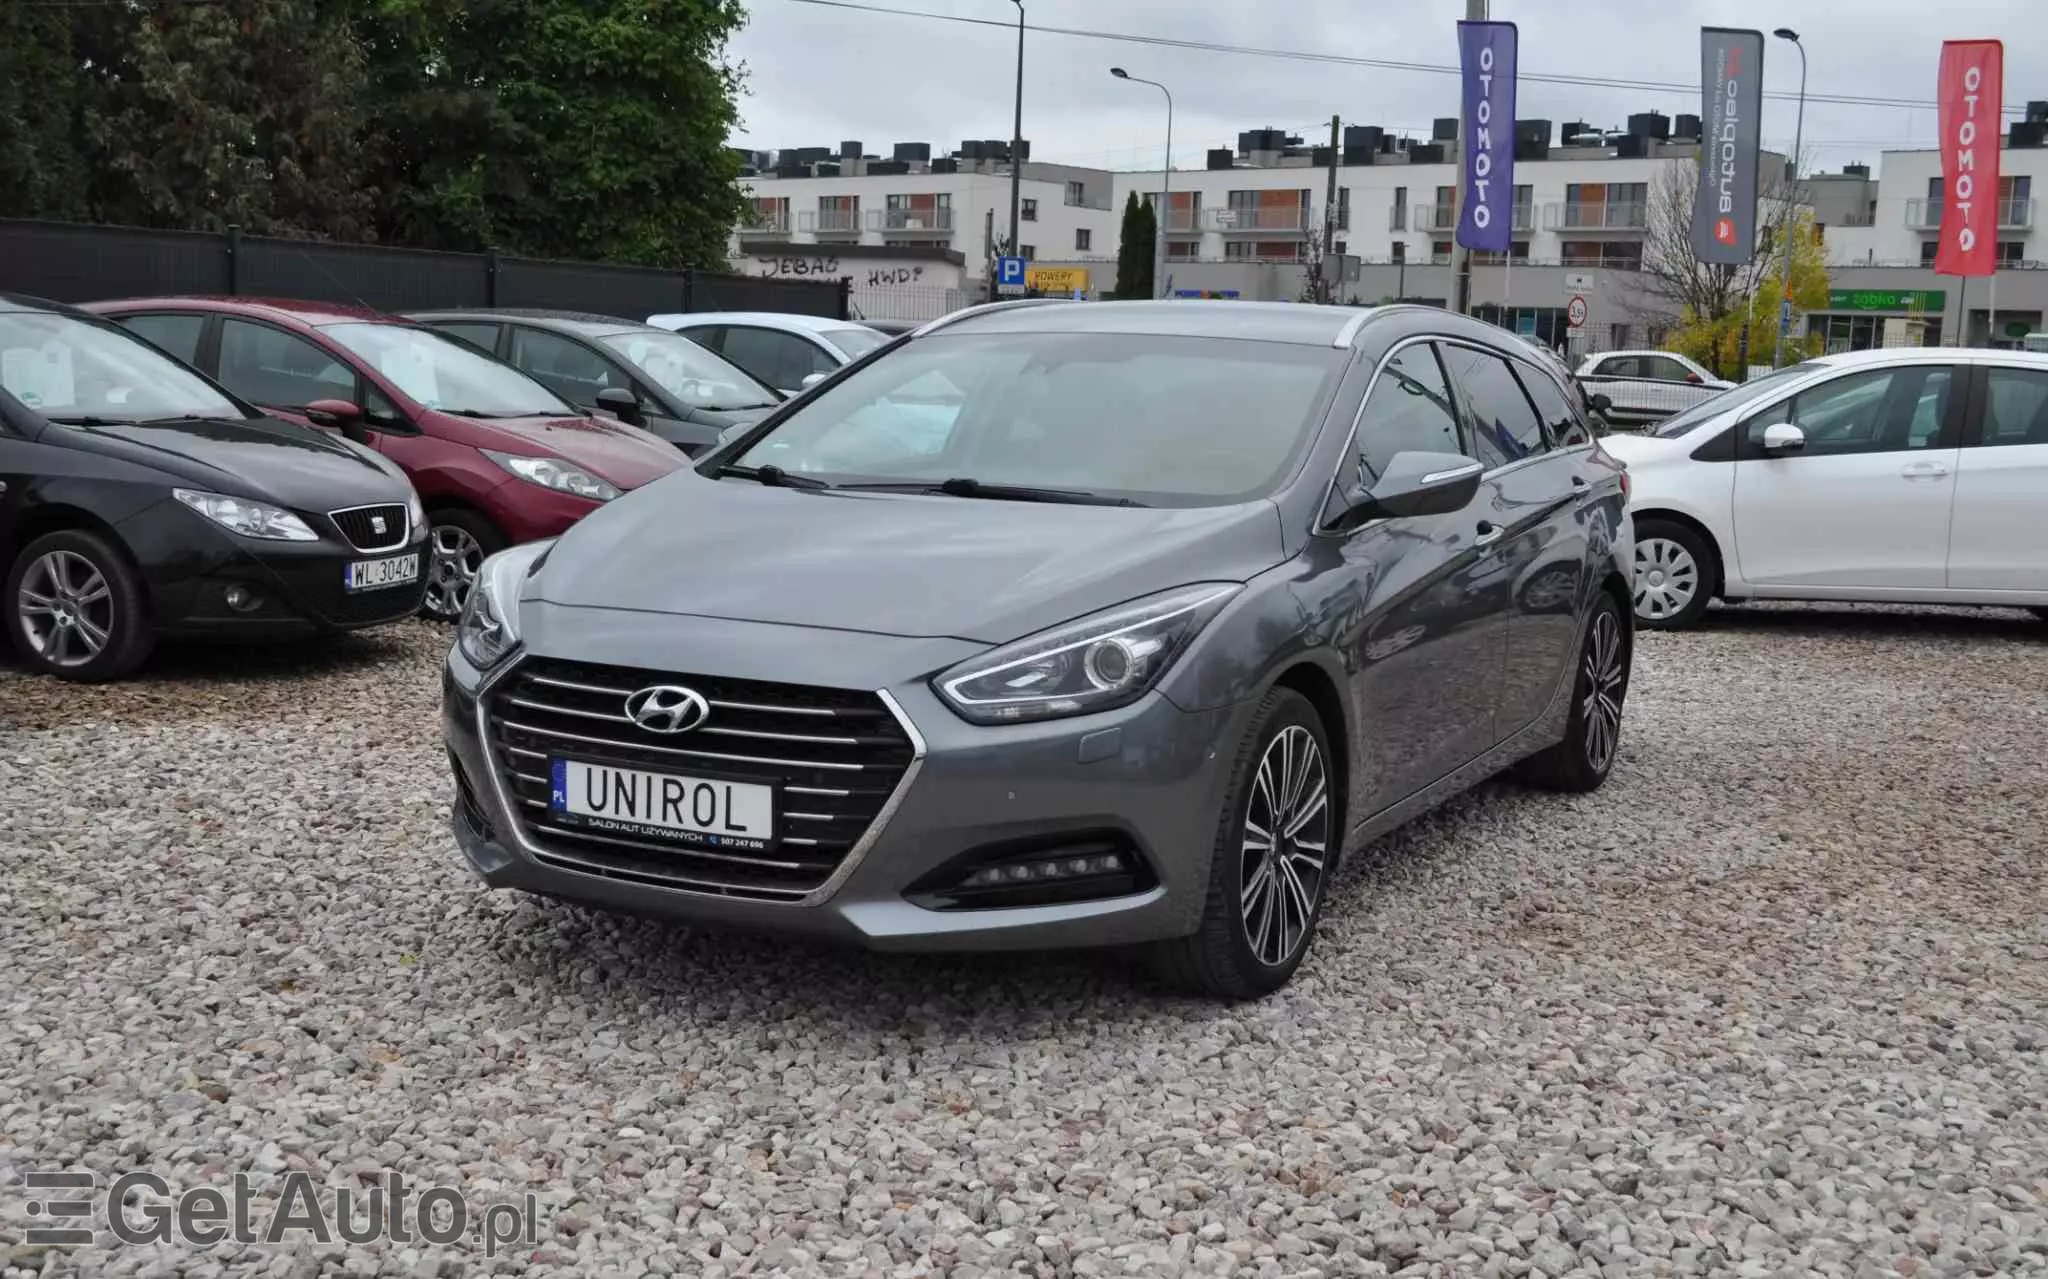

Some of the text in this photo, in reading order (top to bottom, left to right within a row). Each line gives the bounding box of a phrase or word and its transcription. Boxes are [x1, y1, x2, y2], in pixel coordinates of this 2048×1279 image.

[1474, 47, 1493, 229] OTOMOTO
[1956, 65, 1981, 253] OTOMOTO
[1004, 260, 1020, 281] P
[354, 556, 417, 586] WL 3042W
[553, 789, 565, 803] PL
[586, 767, 748, 832] UNIROL
